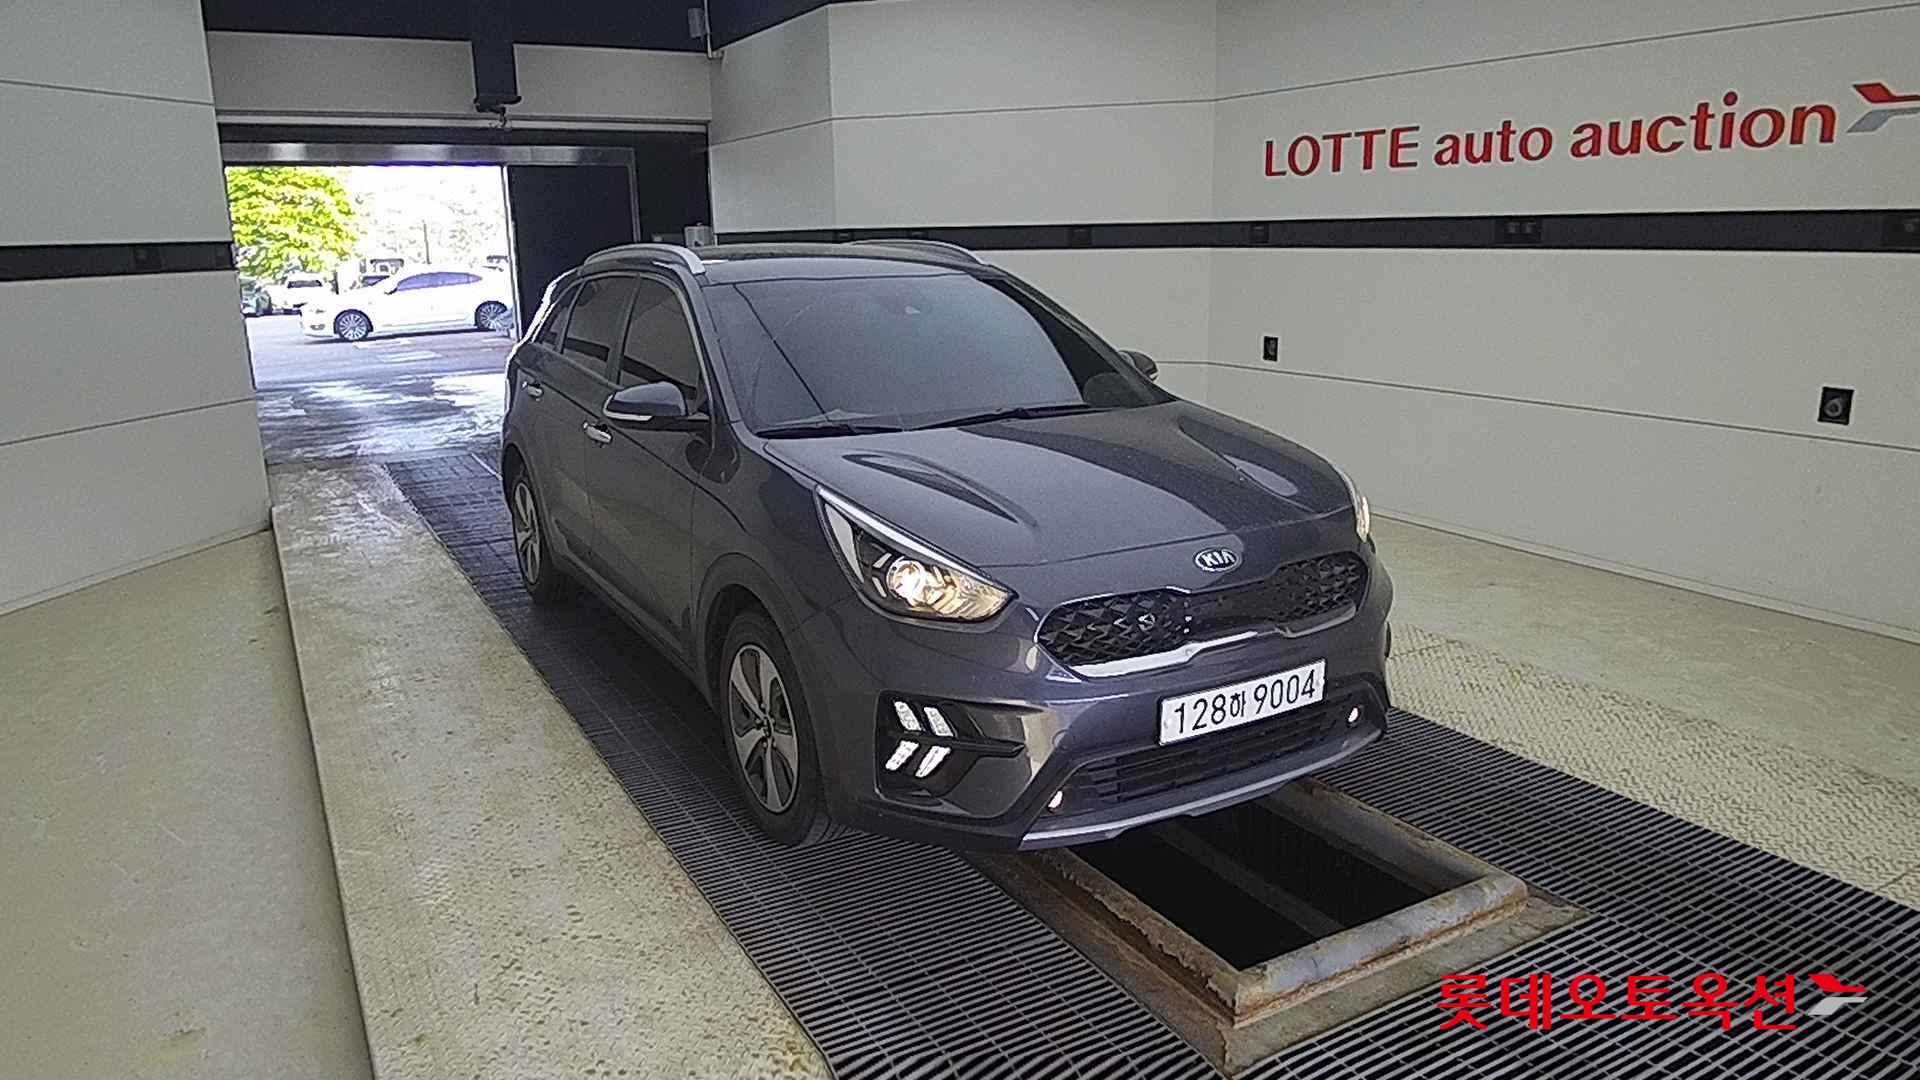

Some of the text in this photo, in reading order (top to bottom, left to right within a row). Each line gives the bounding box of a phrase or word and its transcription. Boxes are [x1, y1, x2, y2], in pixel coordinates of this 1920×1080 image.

[1263, 90, 1837, 178] LOTTE auto auction
[1200, 548, 1236, 567] KIA
[1173, 669, 1316, 734] 128하 9004
